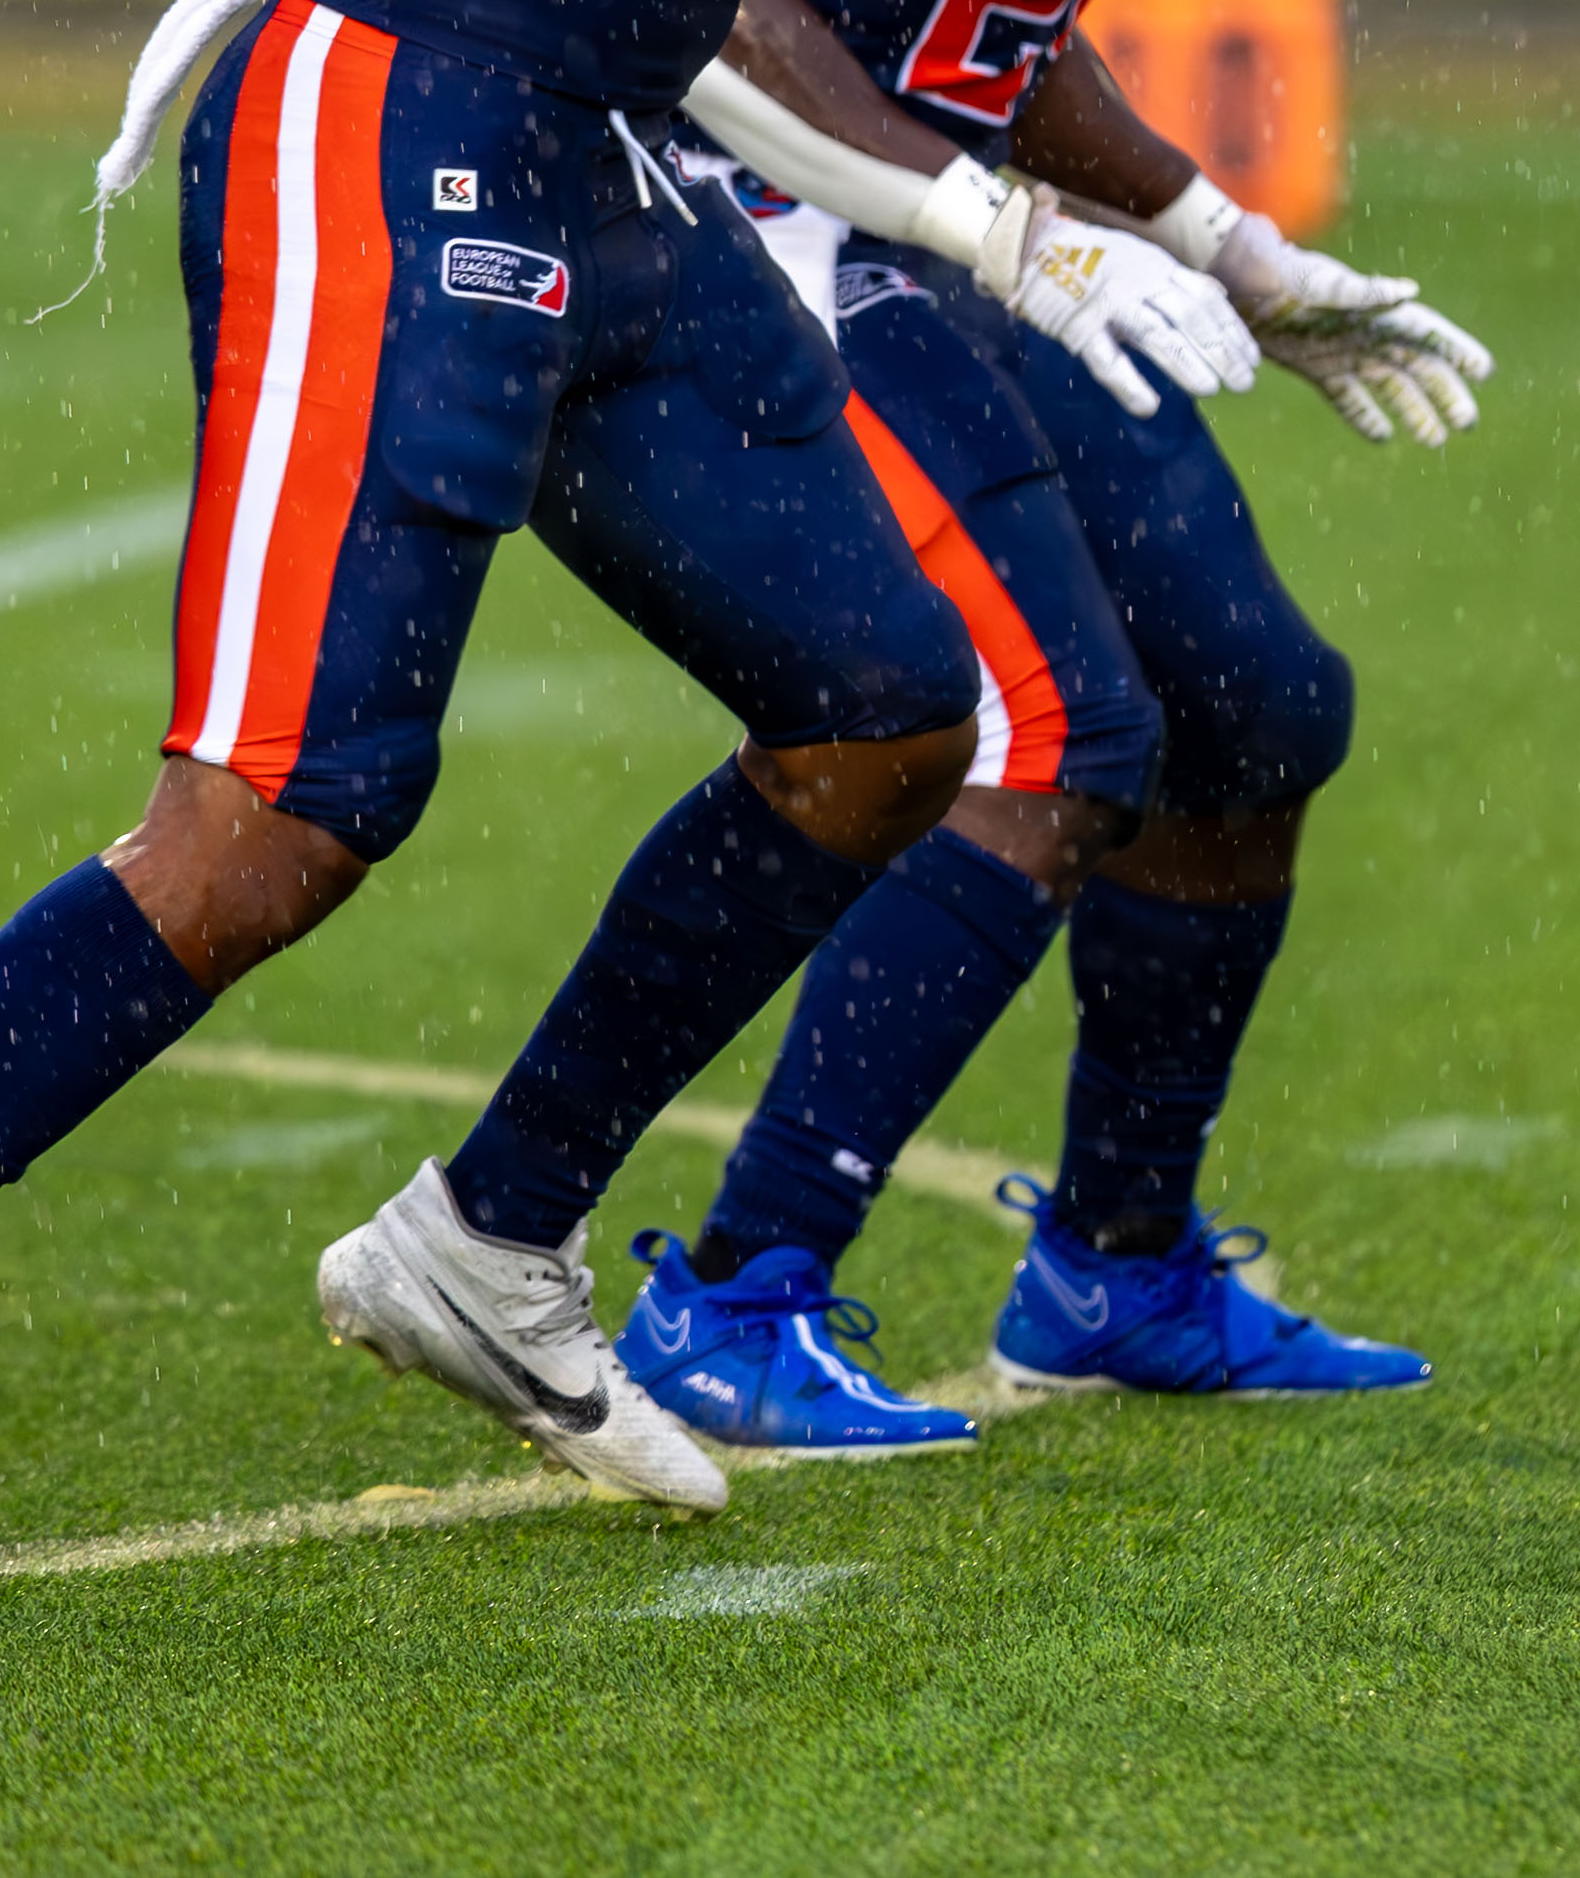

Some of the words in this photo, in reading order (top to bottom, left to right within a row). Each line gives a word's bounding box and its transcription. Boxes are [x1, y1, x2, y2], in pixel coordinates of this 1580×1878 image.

[452, 248, 521, 268] EUROPEAN
[452, 260, 502, 276] LEAGUE
[451, 273, 516, 292] FOOTBALL
